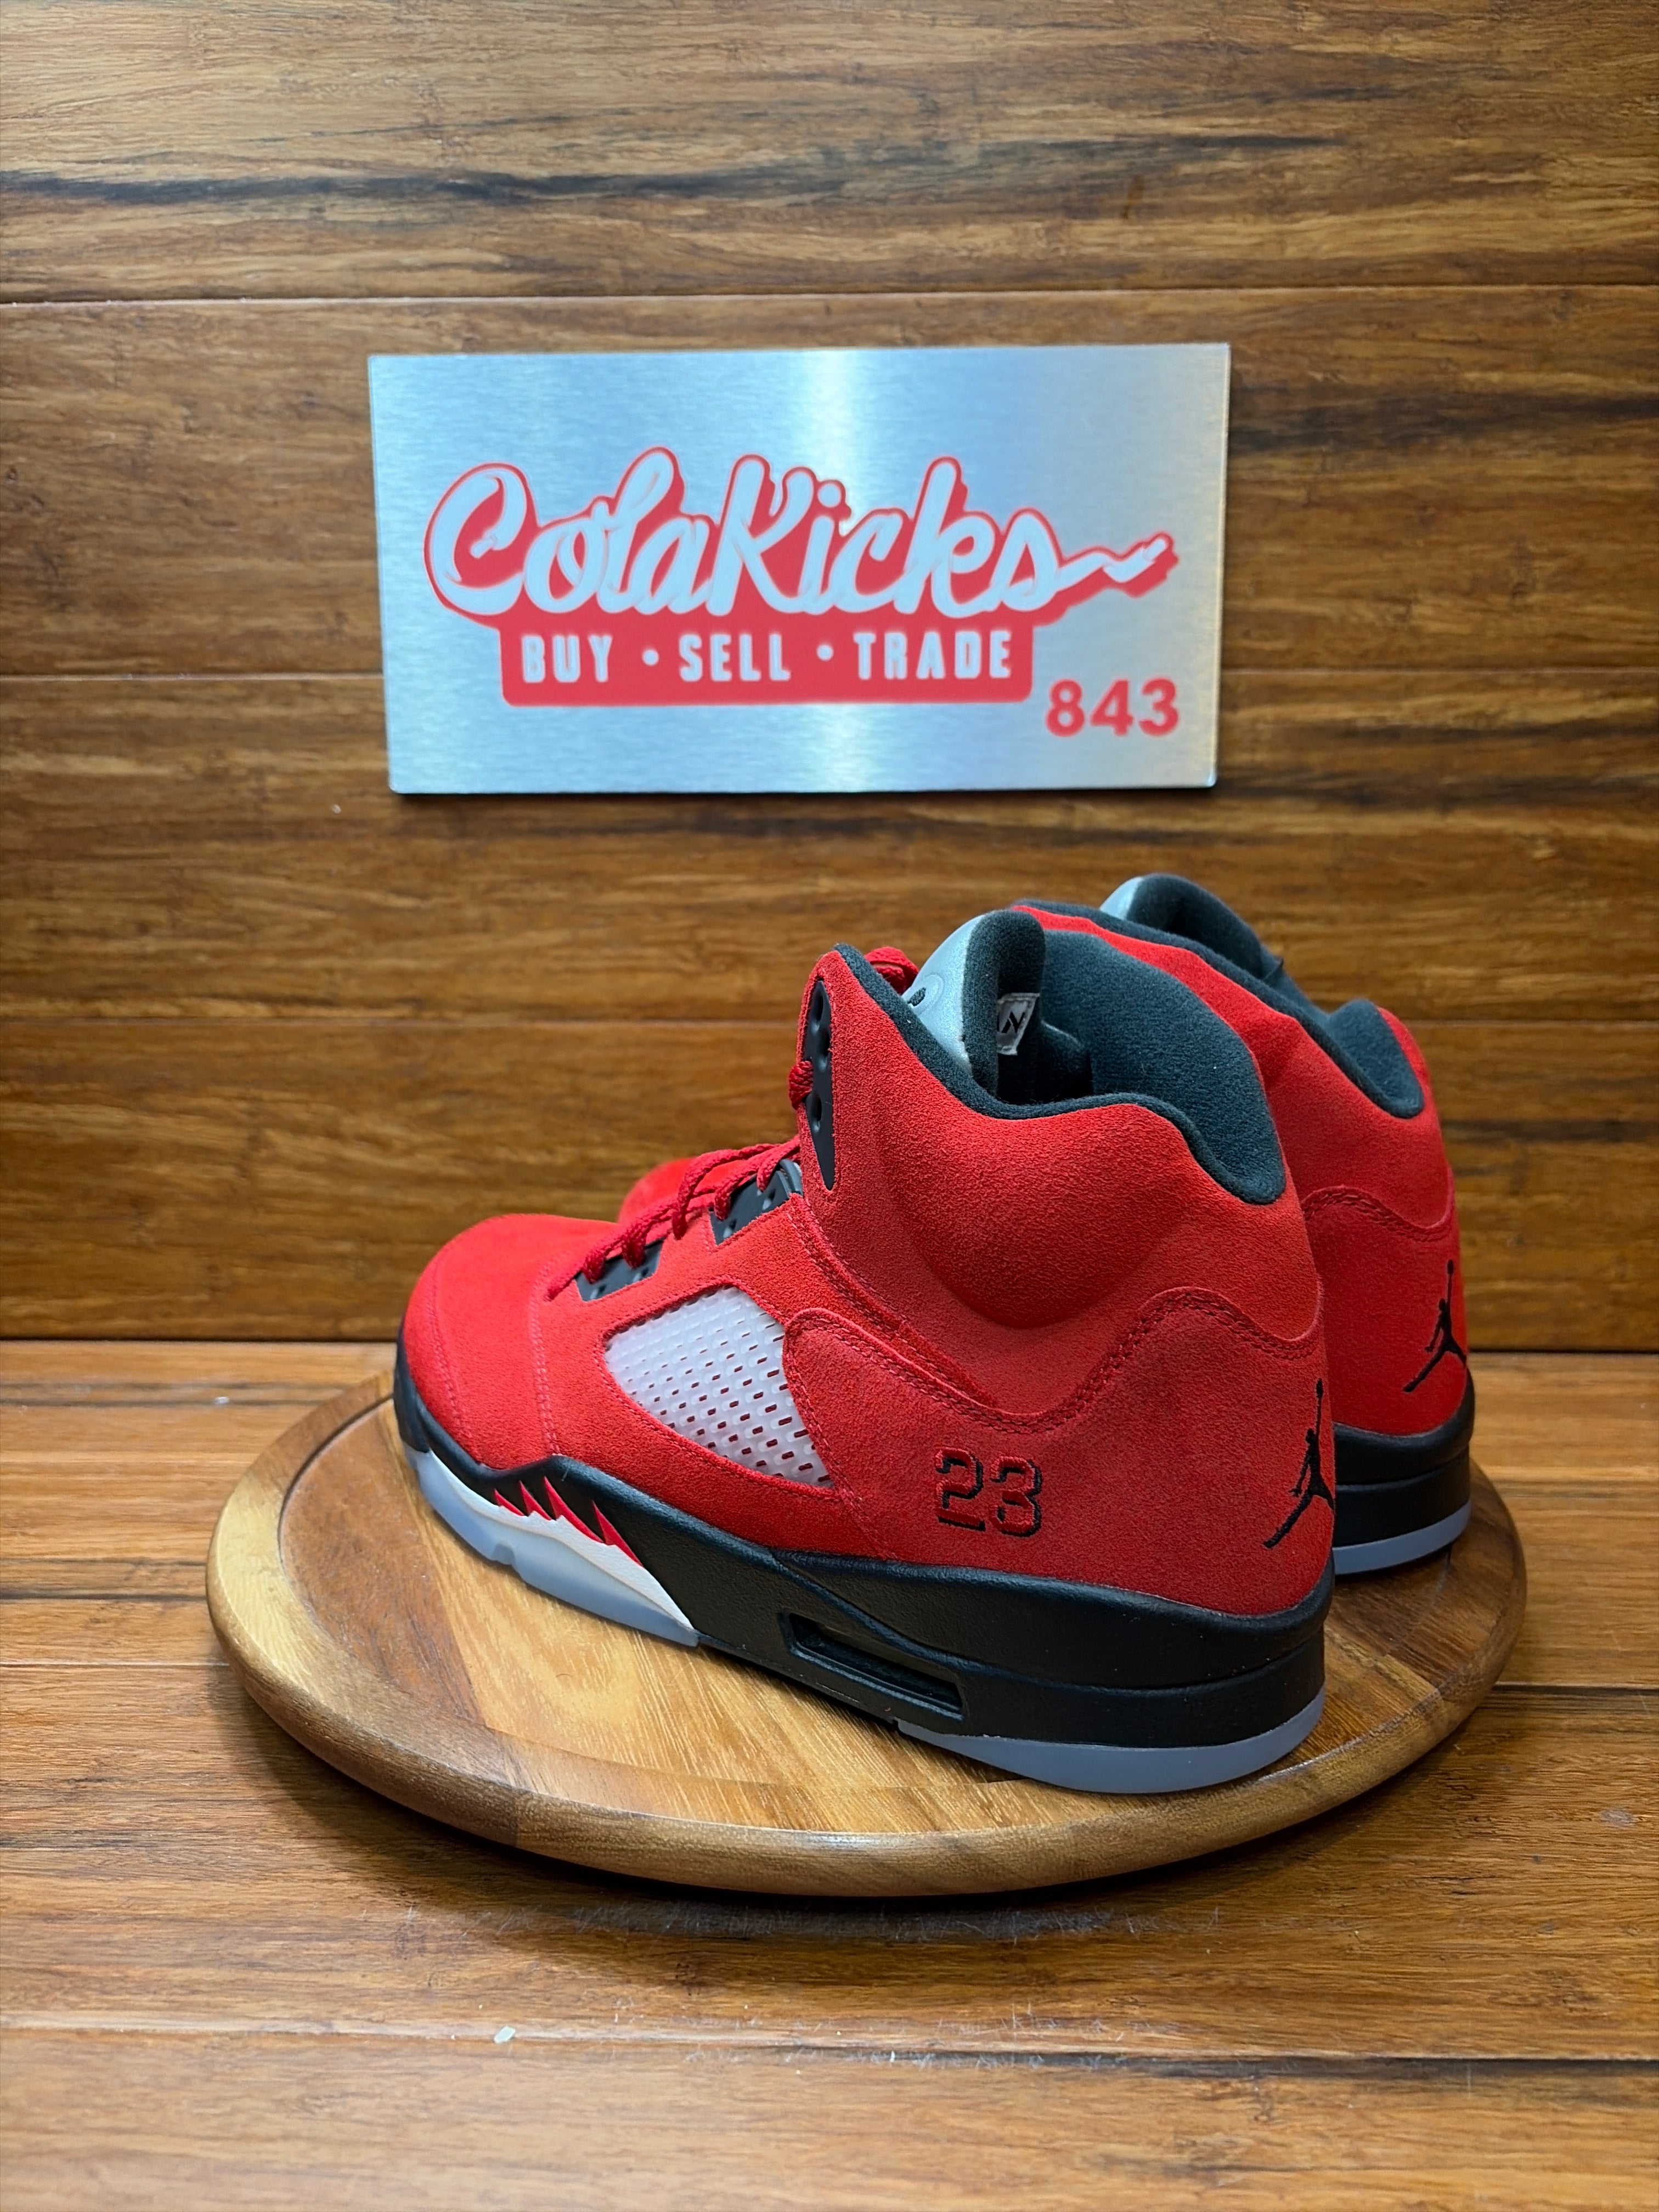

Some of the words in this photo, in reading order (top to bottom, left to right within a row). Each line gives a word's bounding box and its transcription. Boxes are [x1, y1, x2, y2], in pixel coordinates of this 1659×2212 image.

[425, 447, 1178, 619] ColaKicks
[521, 634, 613, 684] BUY
[679, 633, 791, 681] SELL
[853, 630, 1013, 680] TRADE
[1046, 678, 1181, 737] 843
[934, 1446, 1042, 1538] 23
